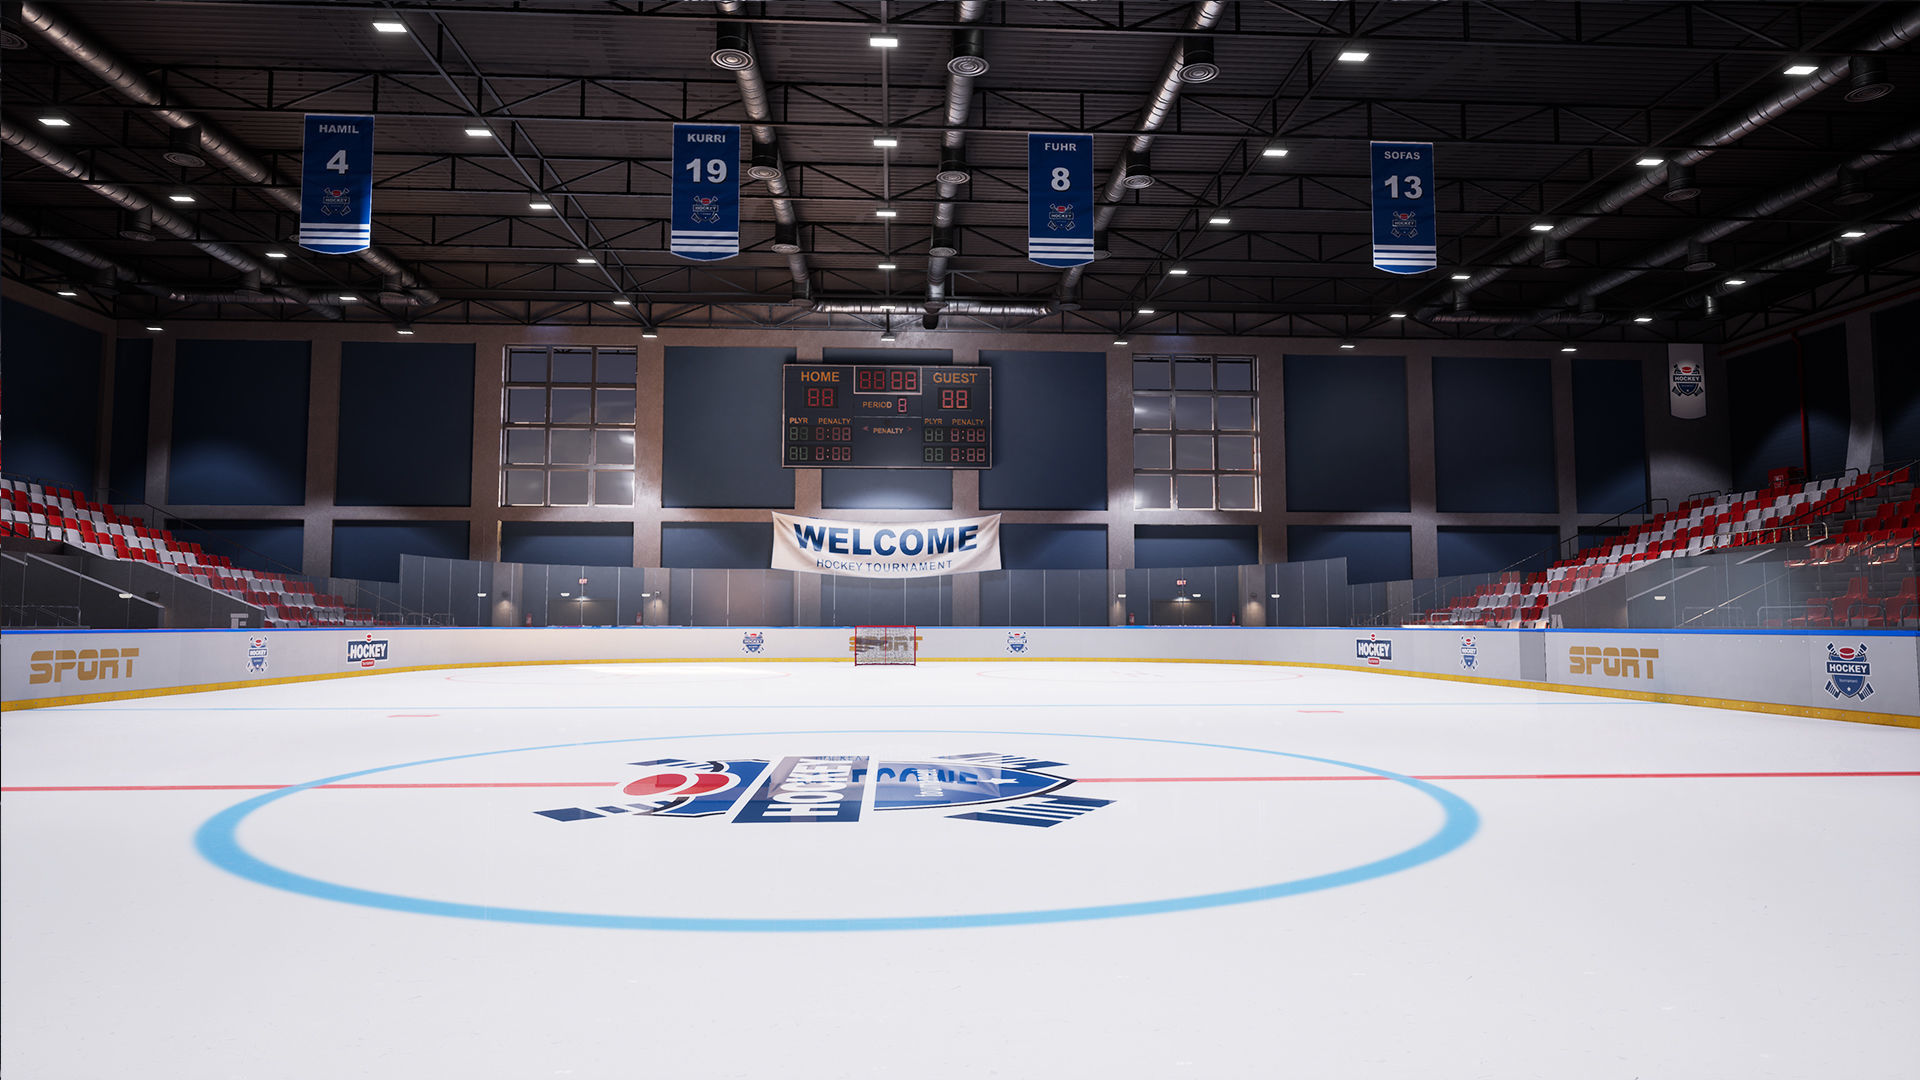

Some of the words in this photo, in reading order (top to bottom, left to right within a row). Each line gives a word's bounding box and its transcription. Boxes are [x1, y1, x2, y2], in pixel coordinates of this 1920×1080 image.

[319, 124, 360, 134] HAMIL
[687, 133, 726, 143] KURRI
[1044, 142, 1077, 151] FUHR
[326, 149, 349, 175] 4
[1384, 151, 1421, 160] SOFAS
[686, 158, 728, 183] 19
[1050, 167, 1071, 191] 8
[1384, 175, 1423, 199] 13
[801, 371, 840, 382] HOME
[933, 372, 978, 383] GUEST
[862, 401, 893, 409] PERIOD
[818, 417, 851, 425] PENALTY
[952, 418, 985, 426] PENALTY
[793, 523, 979, 556] WELCOME
[816, 559, 862, 571] HOCKEY
[866, 560, 953, 572] TOURNAMENT
[350, 643, 387, 659] HOCKEY
[1358, 642, 1390, 657] HOCKEY
[29, 648, 140, 684] SPORT
[1569, 646, 1659, 679] SPORT
[1829, 664, 1867, 673] HOCKEY
[762, 758, 853, 816] HOCKEY
